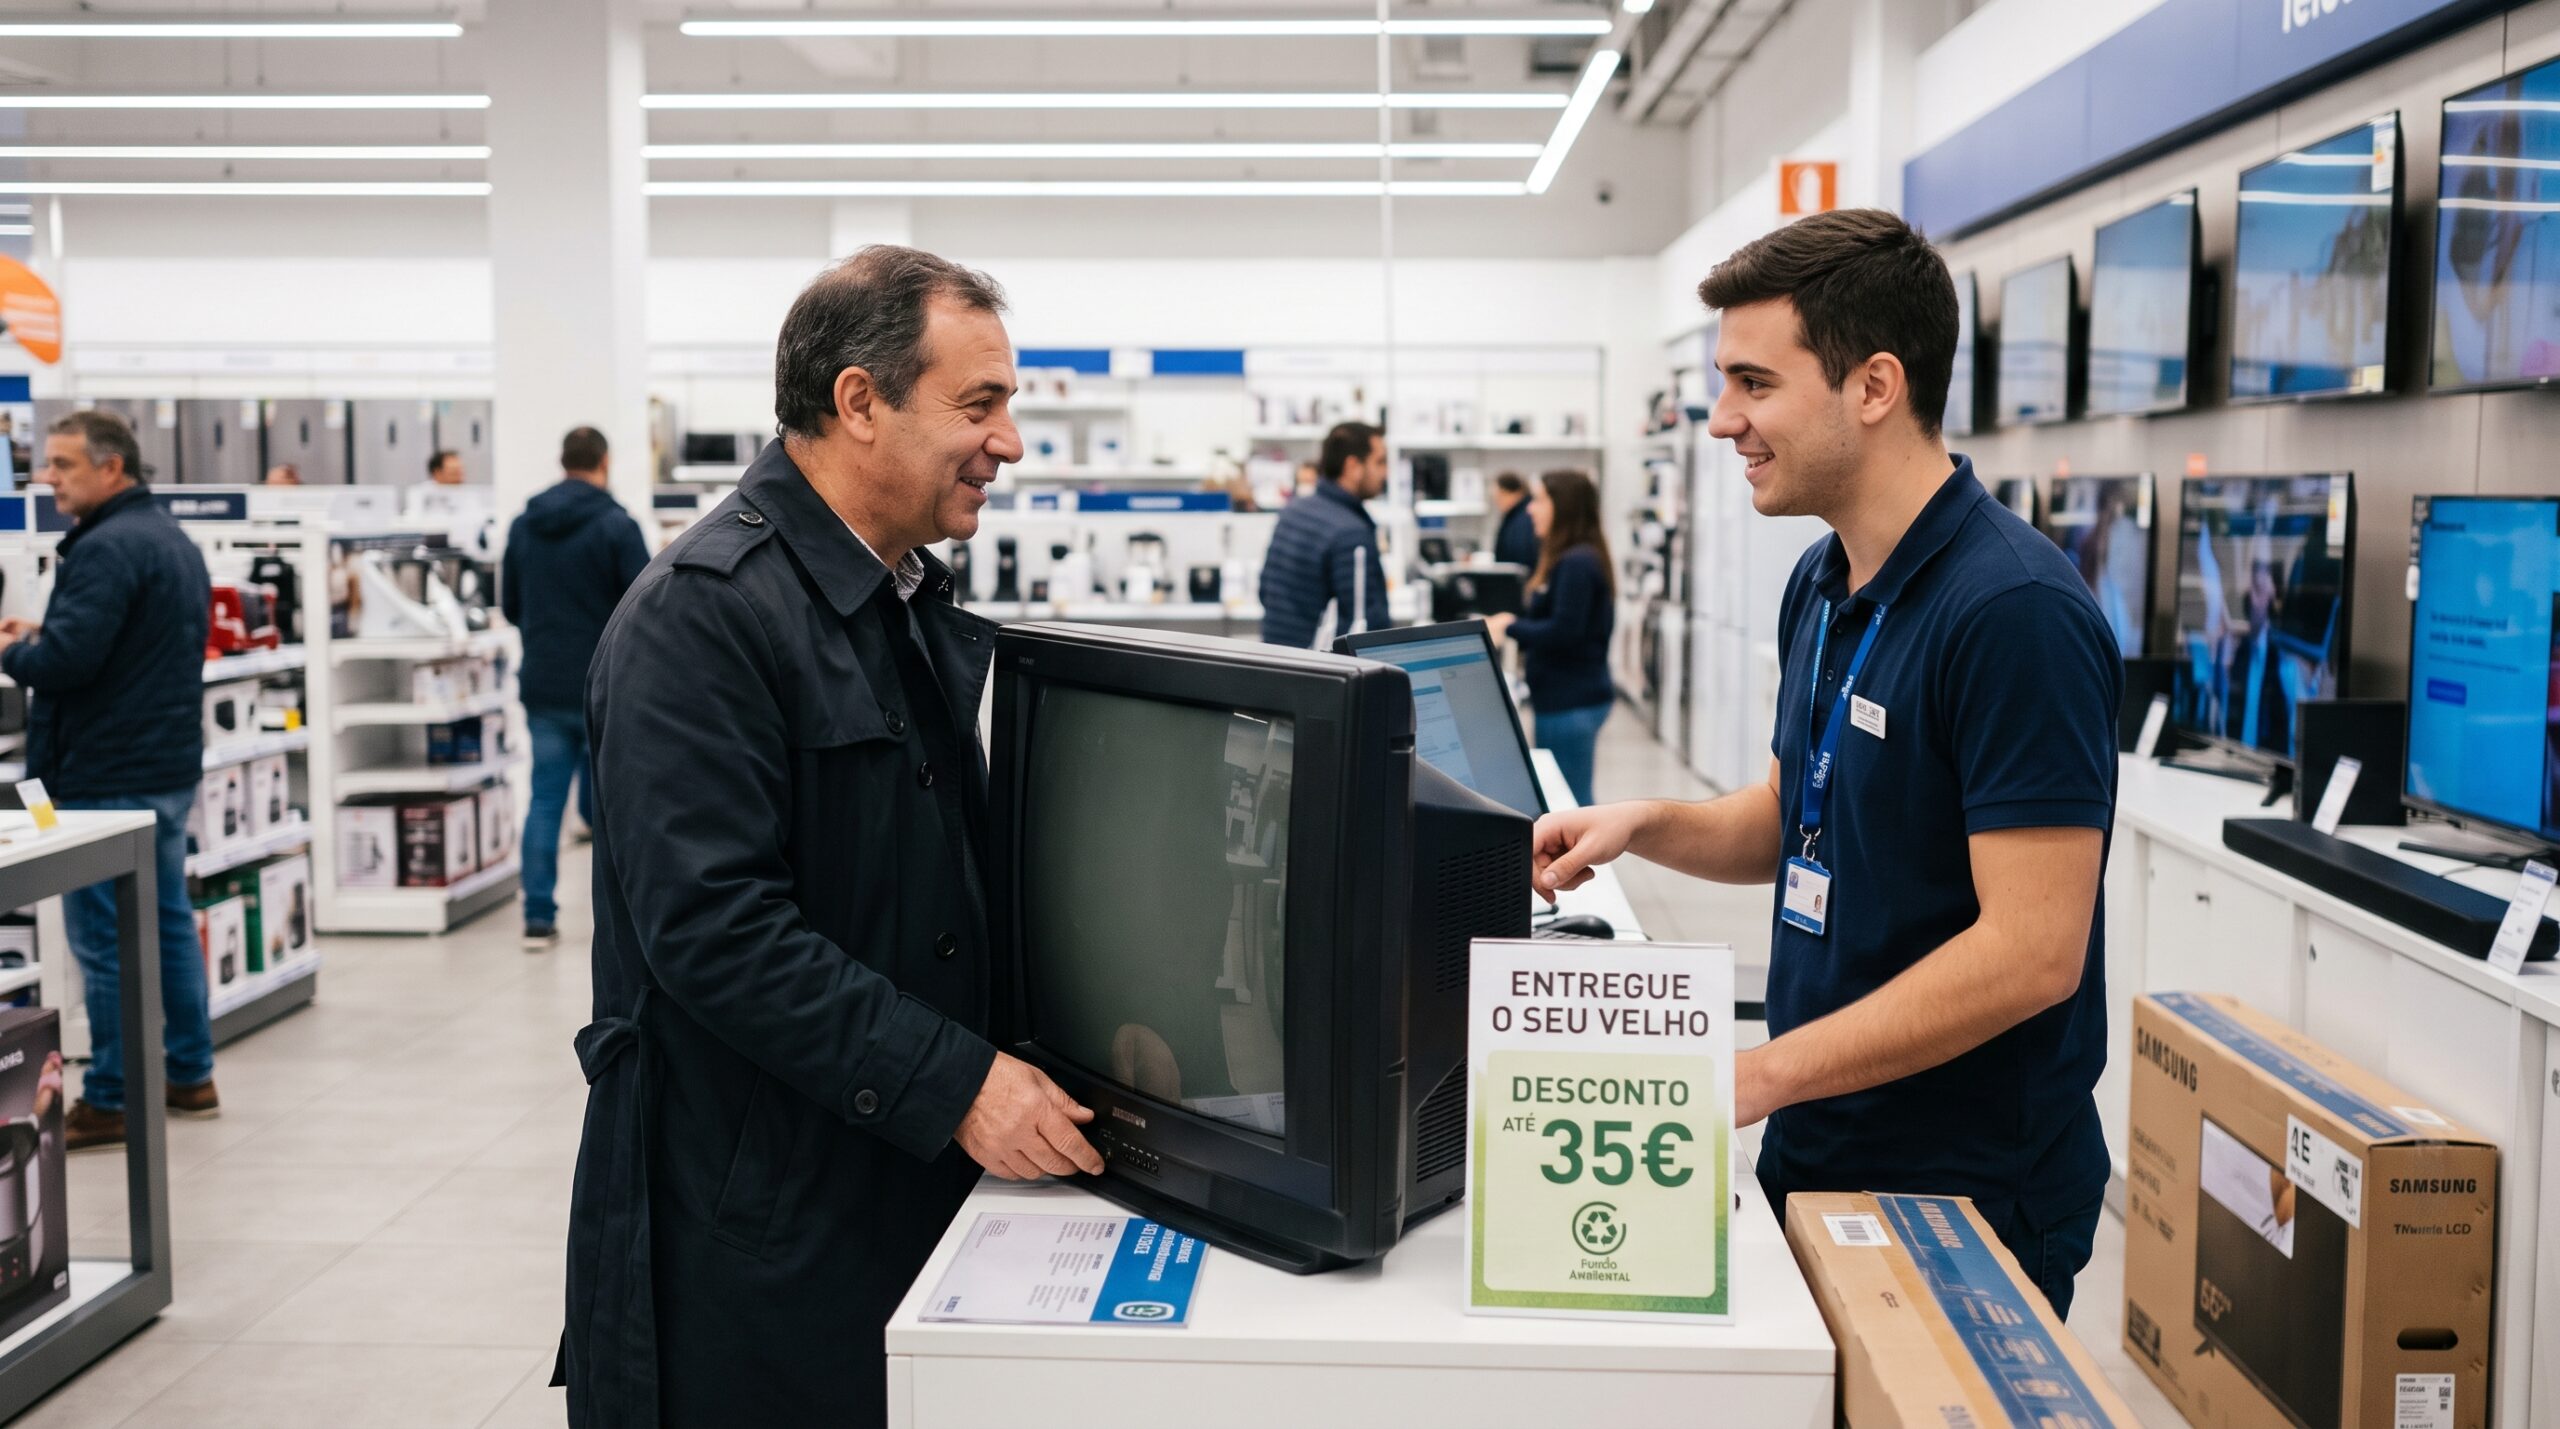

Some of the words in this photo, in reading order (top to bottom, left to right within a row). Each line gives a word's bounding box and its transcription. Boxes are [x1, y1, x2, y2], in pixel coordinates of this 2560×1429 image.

[1512, 971, 1691, 1000] ENTREGUE
[1492, 1006, 1512, 1032] O
[1522, 1006, 1587, 1034] SEU
[1598, 1008, 1709, 1037] VELHO
[2136, 1026, 2197, 1092] SAMSUNG
[1512, 1076, 1689, 1107] DESCONTO
[1502, 1112, 1536, 1132] ATÉ
[1540, 1118, 1695, 1188] 35€
[2389, 1178, 2477, 1194] SAMSUNG
[2445, 1223, 2472, 1235] LCD
